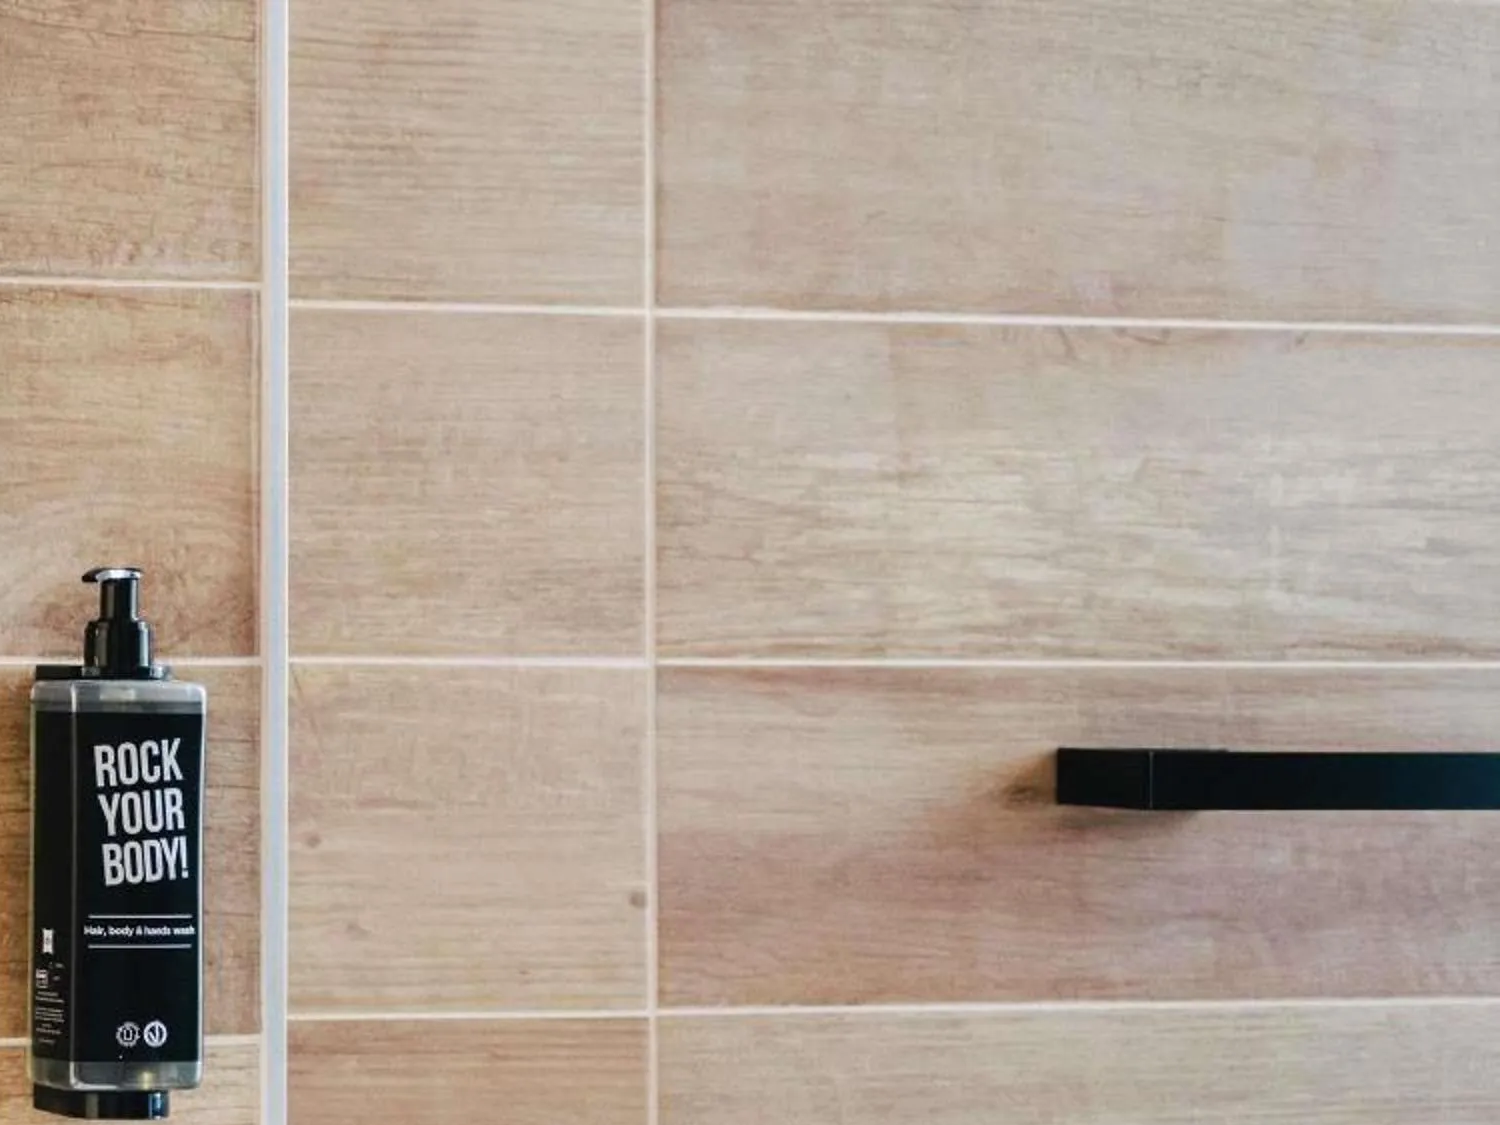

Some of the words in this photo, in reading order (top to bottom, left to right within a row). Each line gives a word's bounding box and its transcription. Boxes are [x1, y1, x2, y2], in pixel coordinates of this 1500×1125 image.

[94, 738, 183, 787] ROCK
[98, 787, 185, 836] YOUR
[102, 836, 189, 886] BODY!
[84, 926, 106, 937] Hair,
[108, 926, 134, 937] body
[135, 926, 143, 936] &
[144, 926, 171, 936] hands
[173, 926, 195, 936] wash
